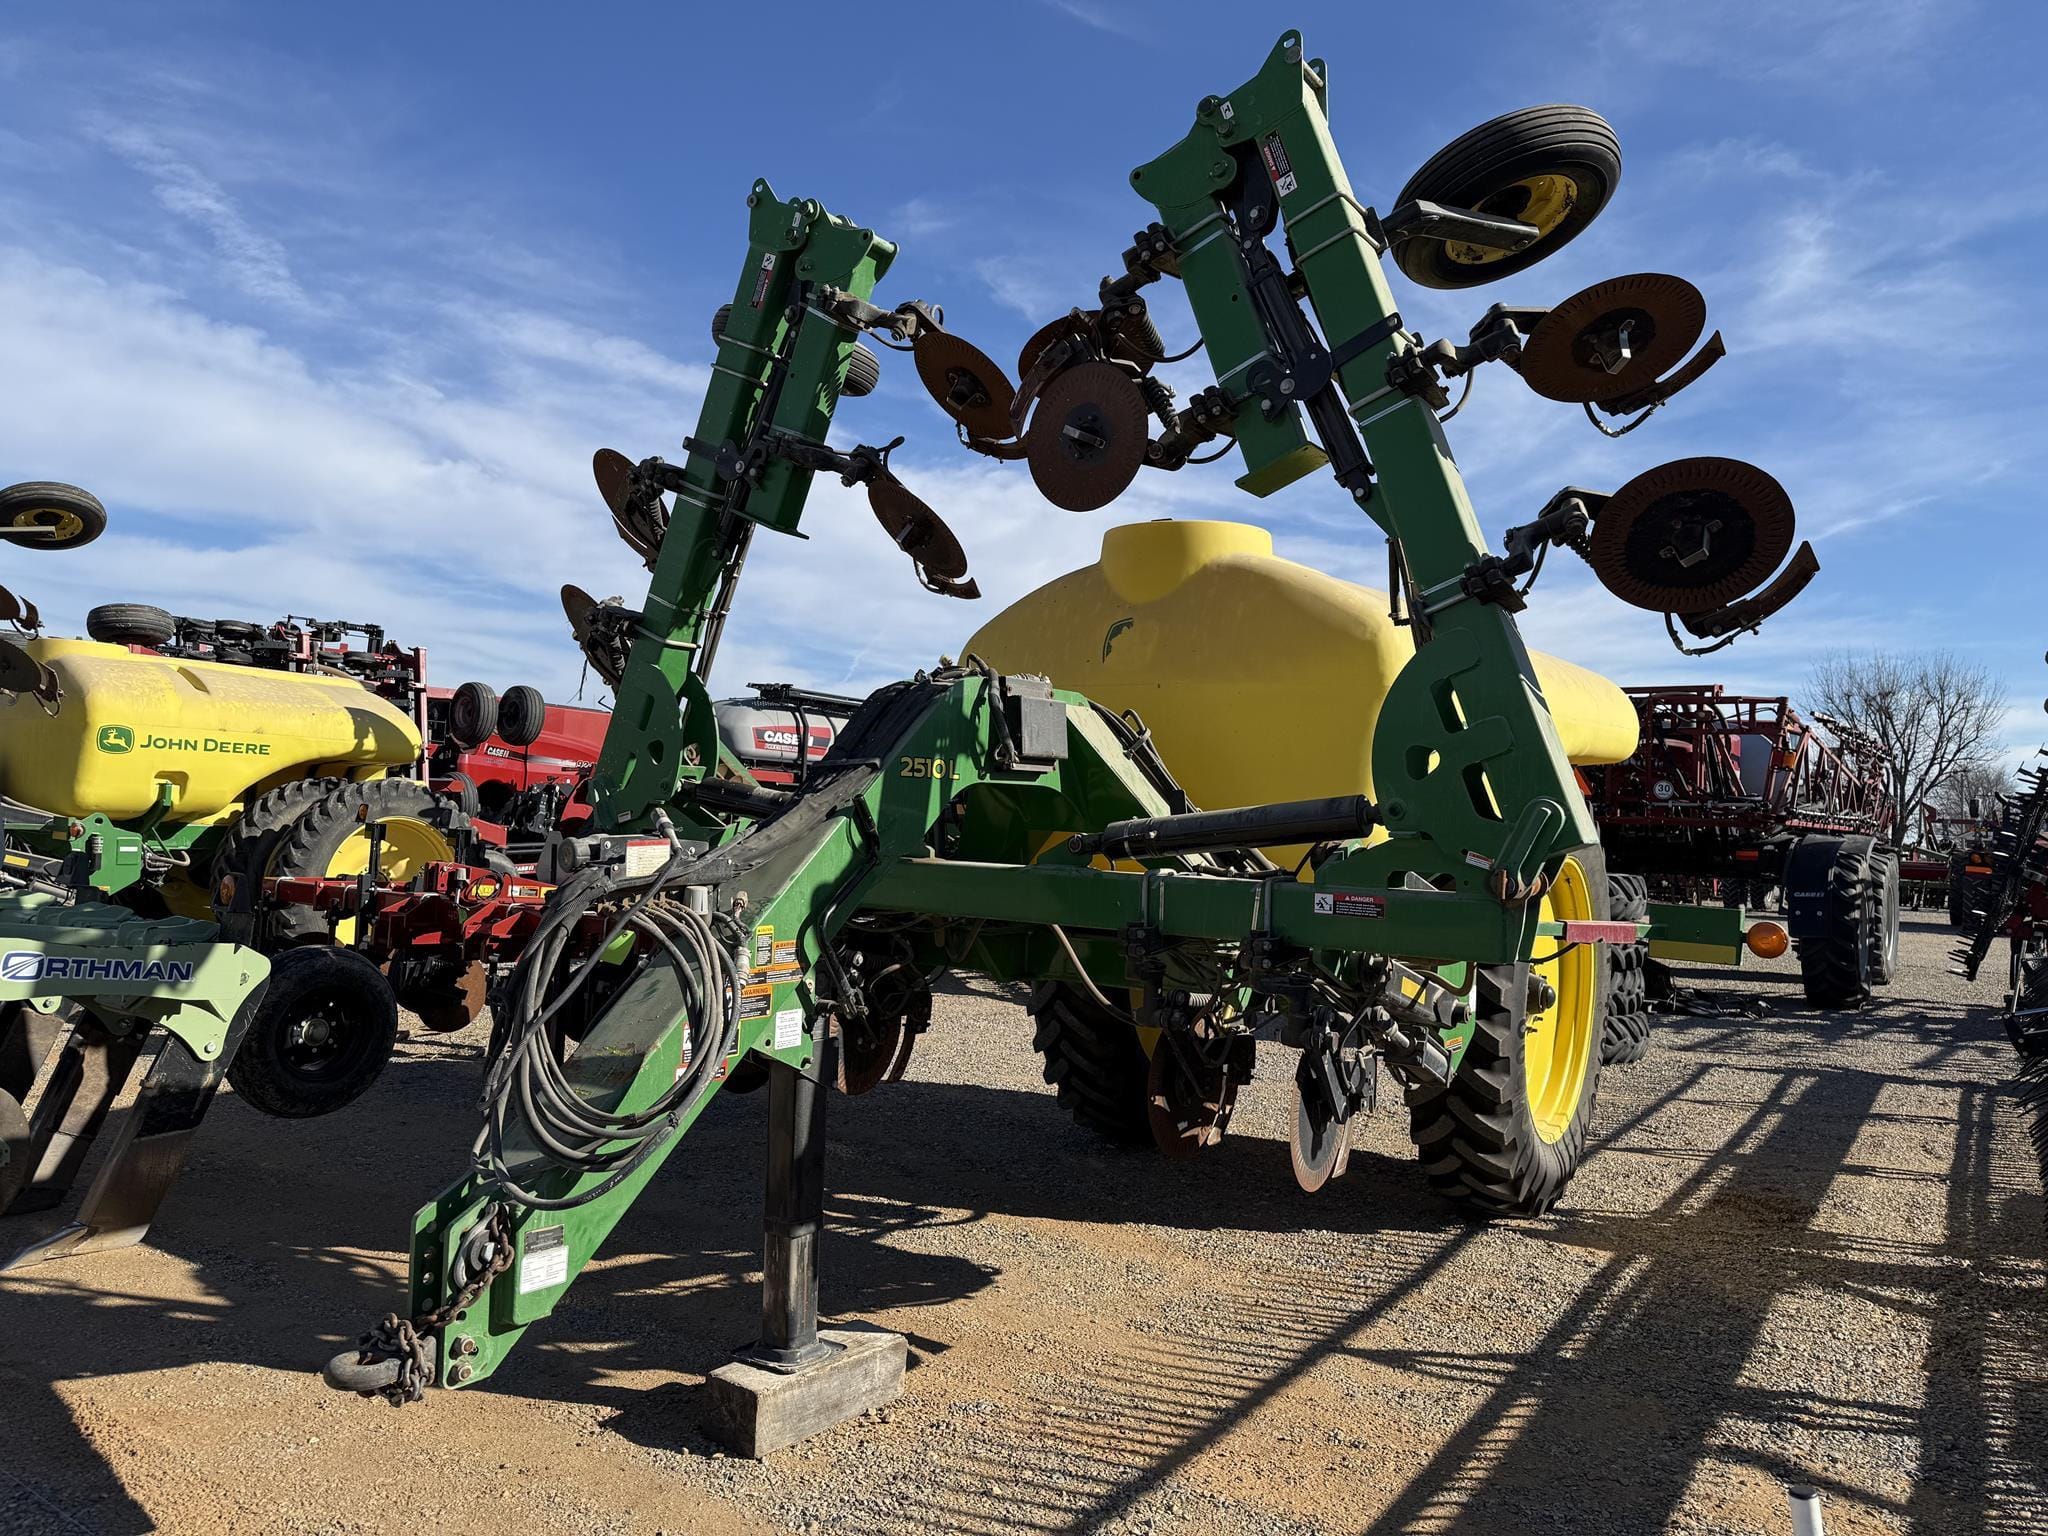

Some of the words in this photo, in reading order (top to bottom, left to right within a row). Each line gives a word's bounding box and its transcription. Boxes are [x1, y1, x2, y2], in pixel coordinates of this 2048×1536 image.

[140, 735, 198, 751] JOHN
[203, 738, 271, 755] DEERE
[1657, 784, 1671, 793] 30
